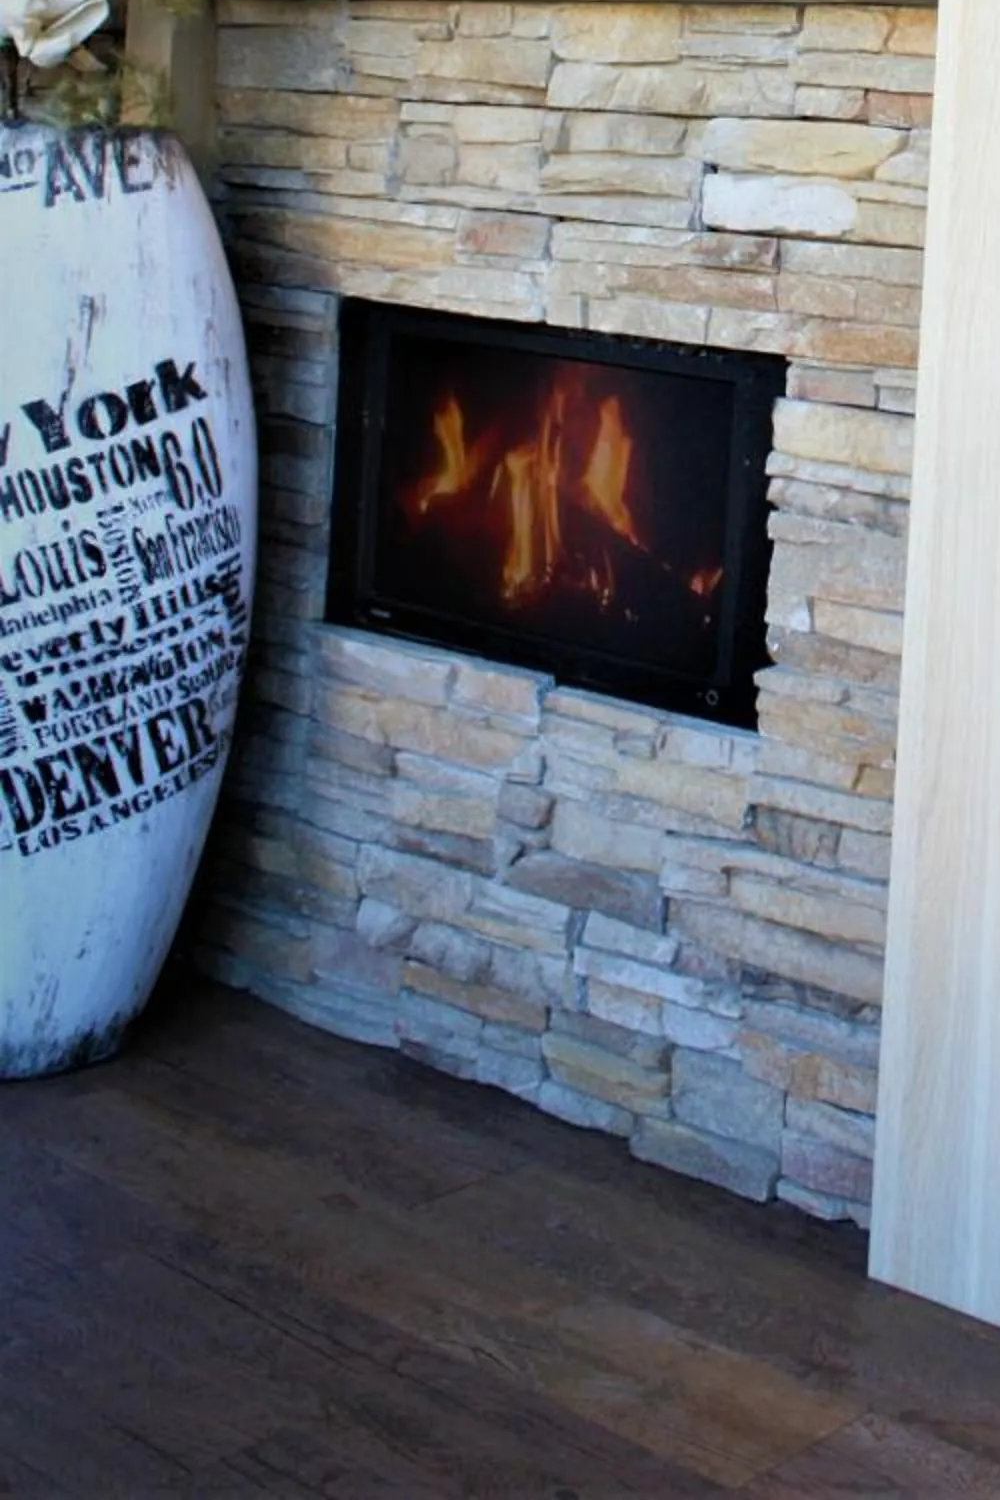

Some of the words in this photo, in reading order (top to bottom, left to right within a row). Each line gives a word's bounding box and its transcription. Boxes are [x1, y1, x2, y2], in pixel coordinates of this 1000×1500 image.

[45, 128, 154, 208] AVE
[0, 431, 162, 523] HOUSTON
[0, 586, 114, 638] ladelphia
[0, 612, 126, 673] everly
[34, 685, 173, 749] PORTLAND
[0, 698, 217, 834] DENVER
